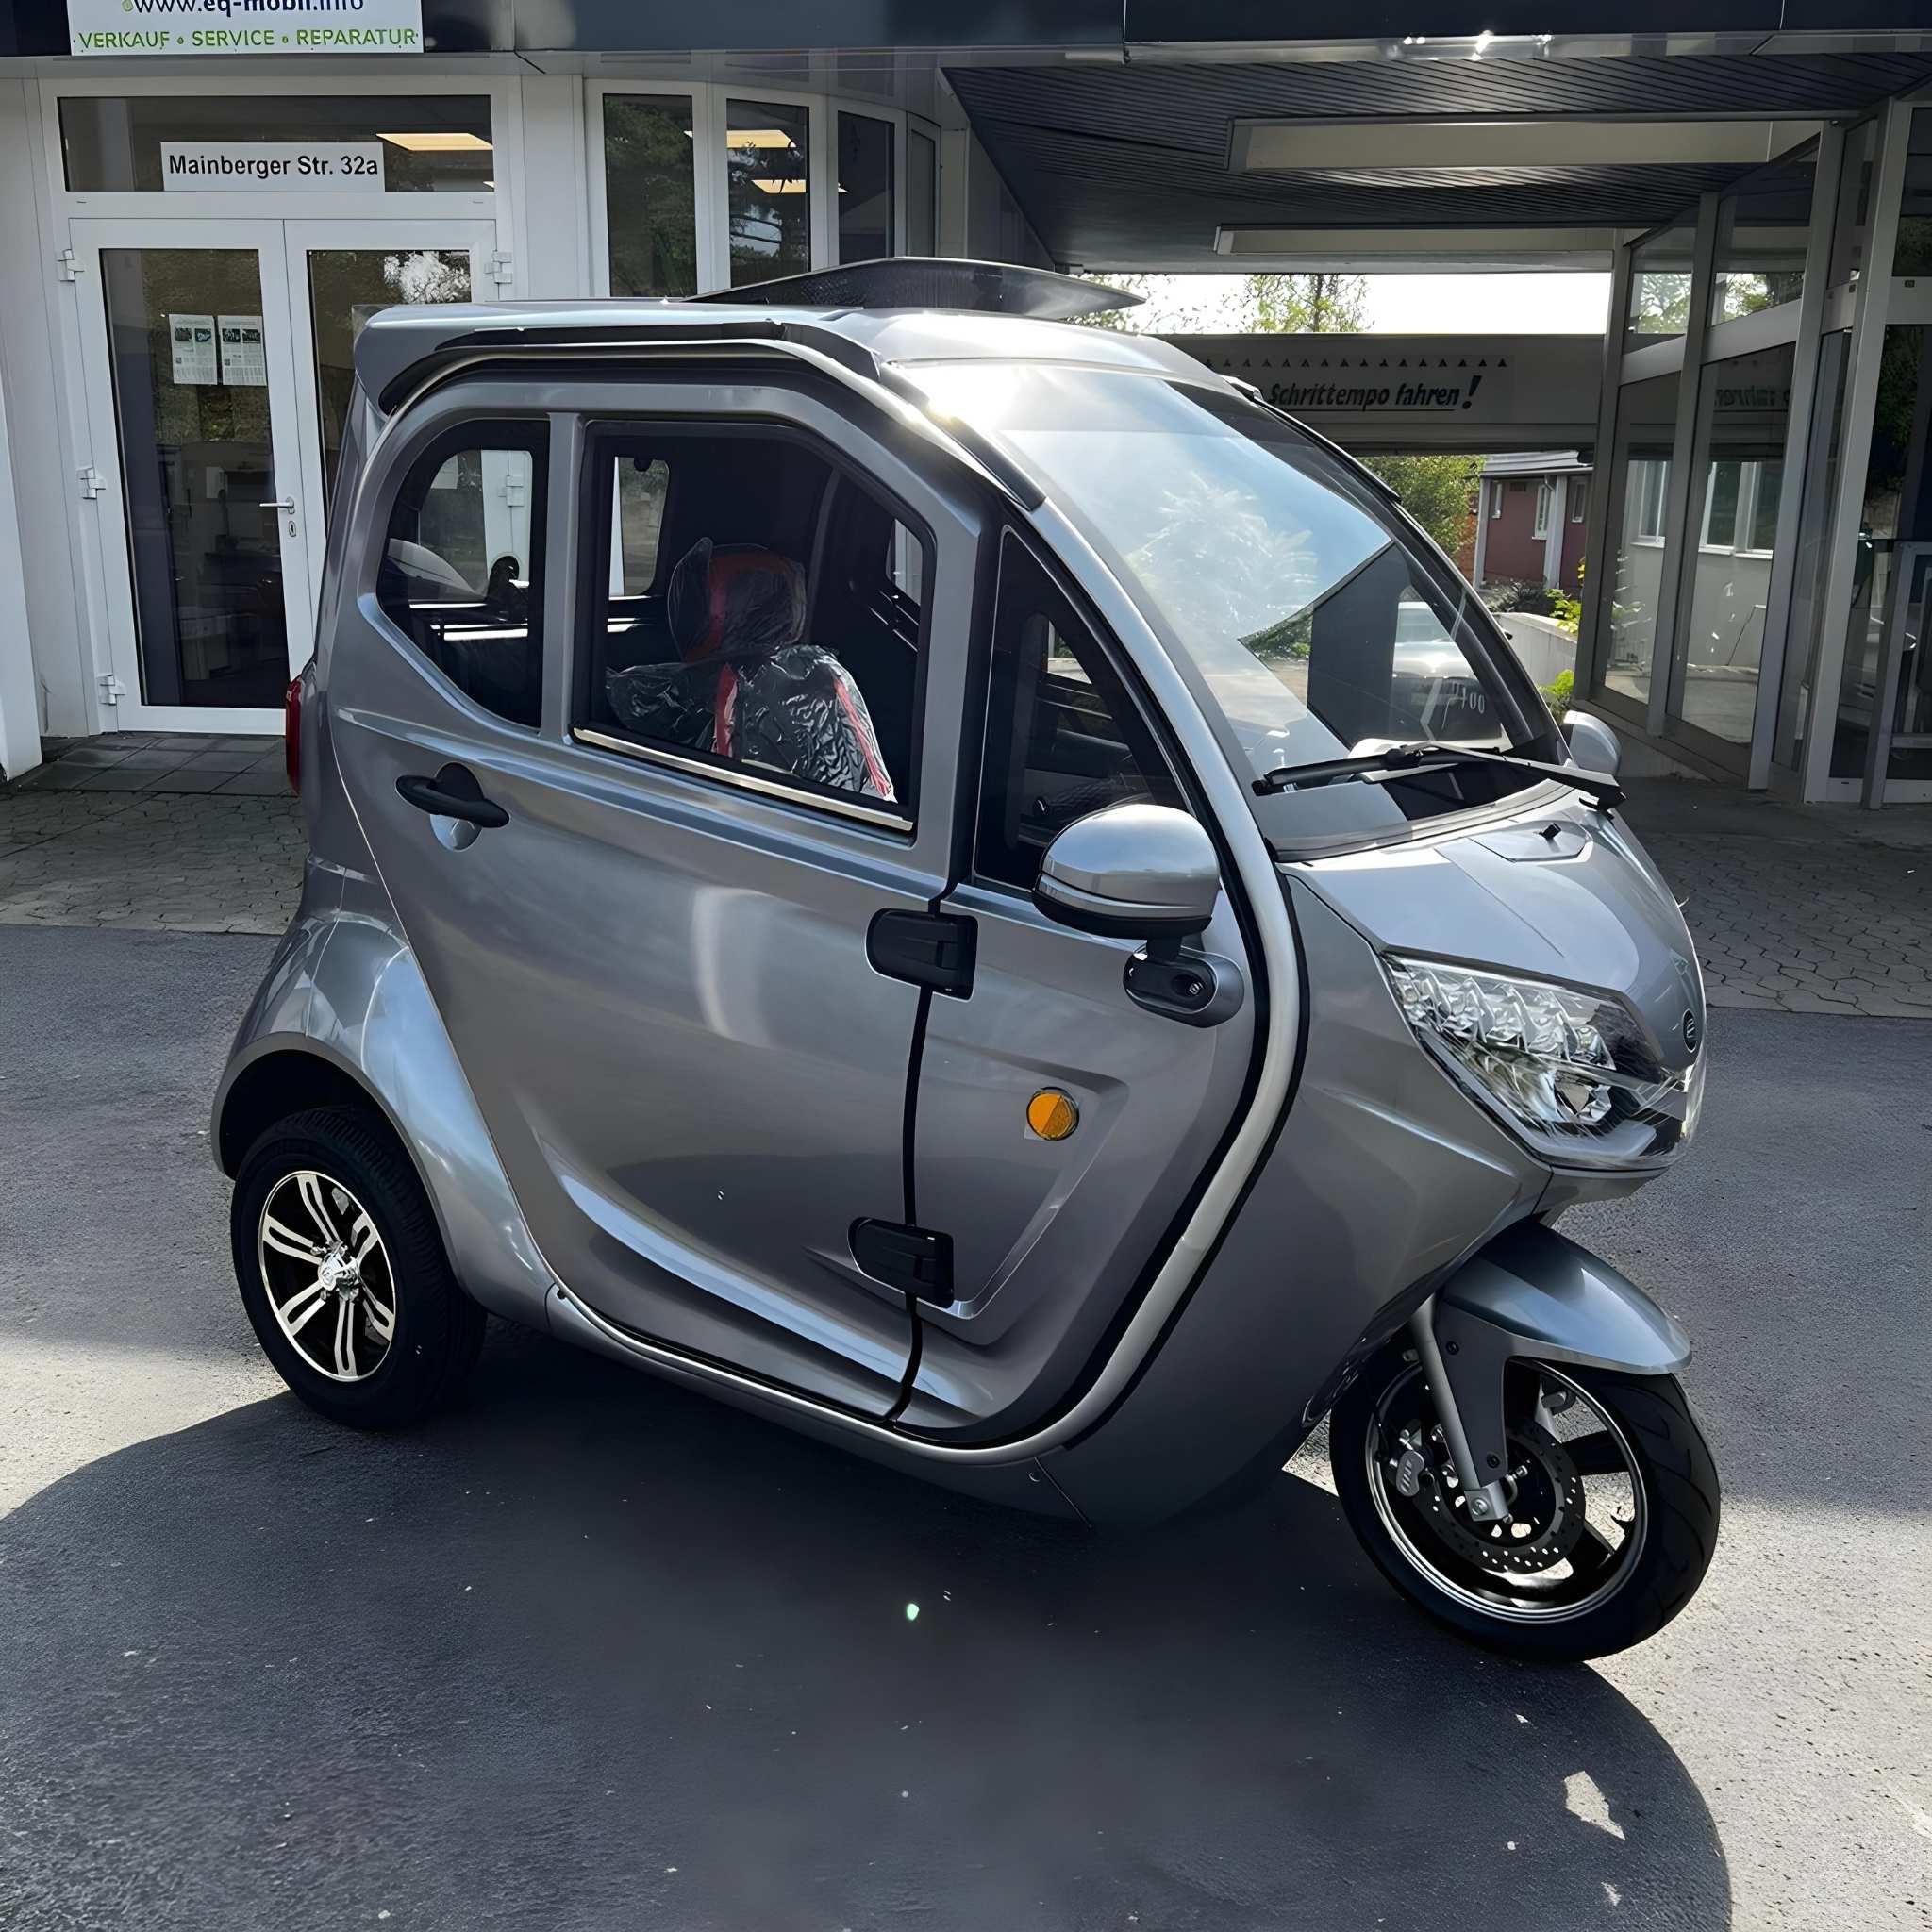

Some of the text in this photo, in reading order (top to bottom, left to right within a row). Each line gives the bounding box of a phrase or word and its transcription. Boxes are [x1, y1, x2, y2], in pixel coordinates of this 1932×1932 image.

[78, 28, 416, 48] VERKAUF SERVICE REPARATUR
[169, 155, 378, 179] Mainberger Str. 32a
[1269, 382, 1390, 411] Schrittempo
